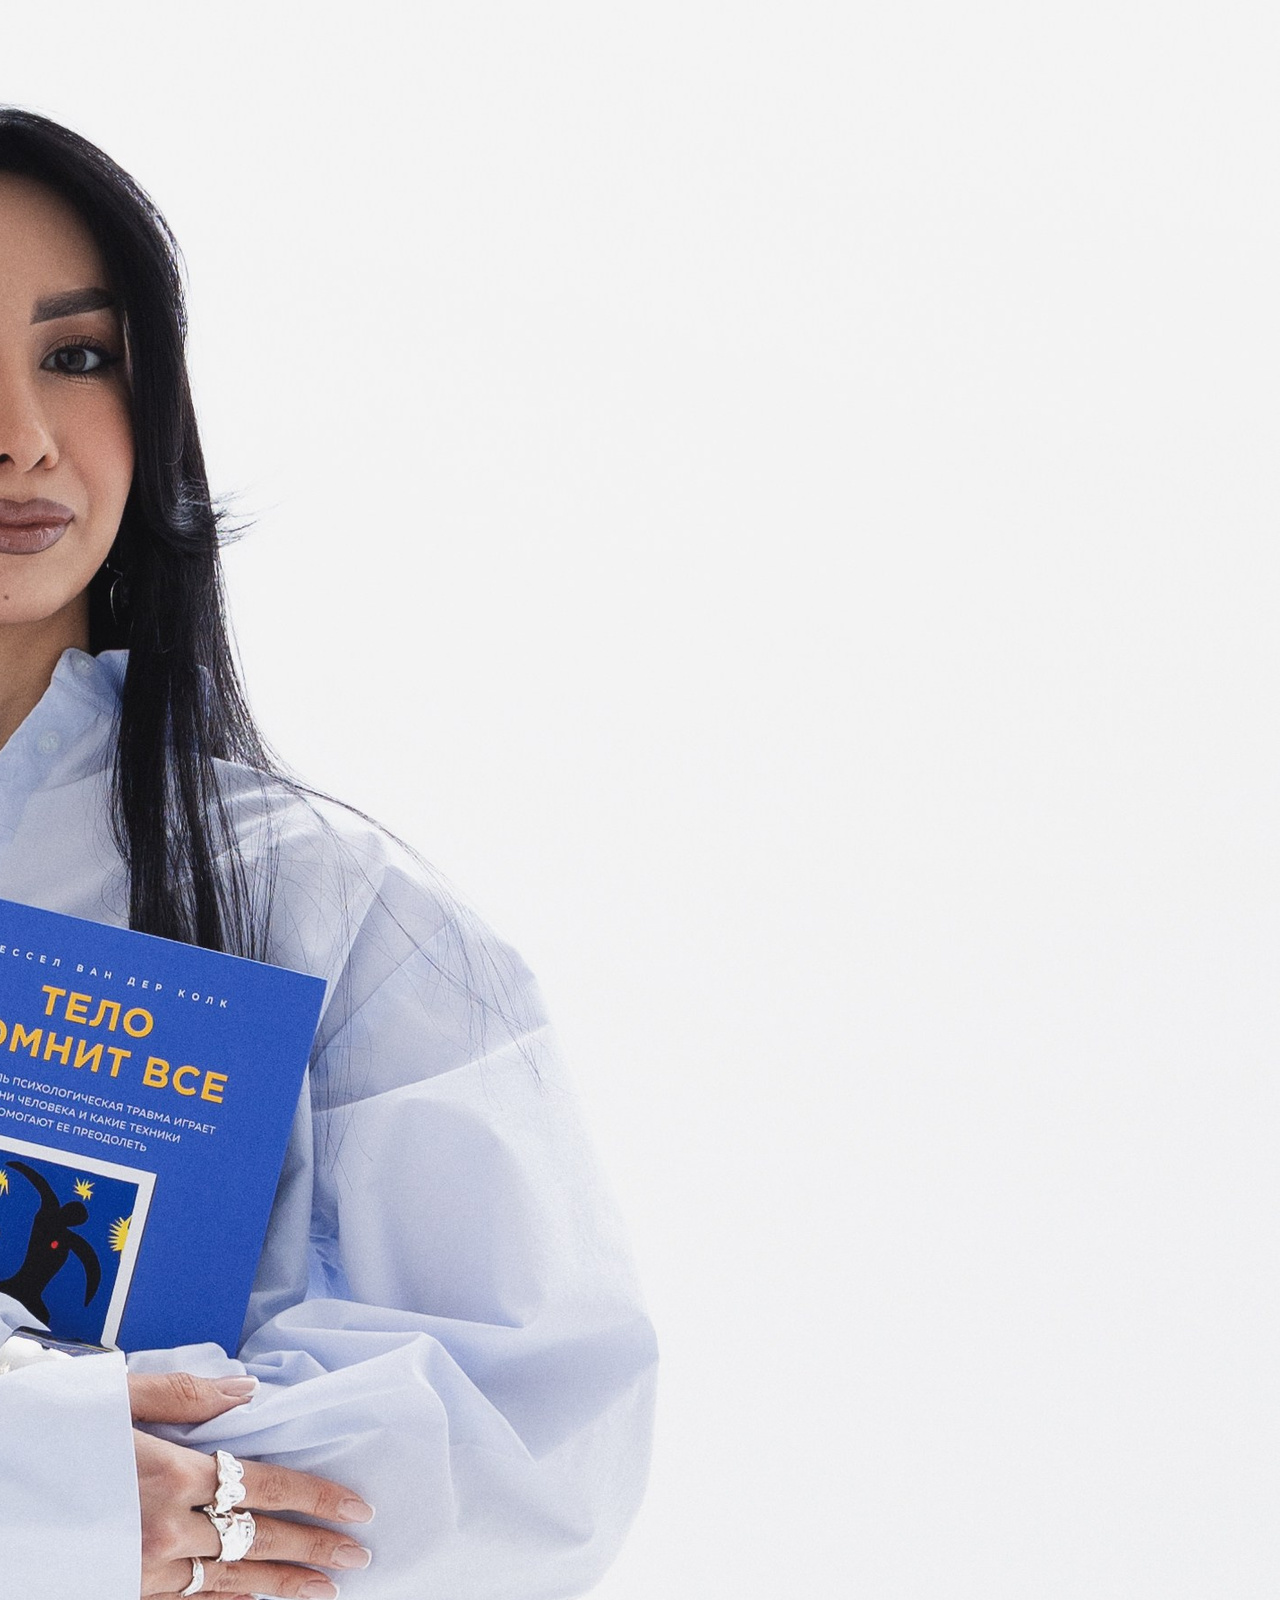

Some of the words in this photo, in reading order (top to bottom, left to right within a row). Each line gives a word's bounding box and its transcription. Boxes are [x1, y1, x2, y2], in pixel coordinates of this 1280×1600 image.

[76, 963, 112, 979] ВАН
[126, 976, 163, 992] ДЕР
[178, 989, 228, 1008] КОЛК
[41, 984, 154, 1038] ТЕЛО
[142, 1055, 229, 1104] ВСЕ
[12, 1076, 124, 1112] ПСИХОЛОГИЧЕСКАЯ
[126, 1104, 171, 1124] ТРАВМА
[173, 1117, 217, 1135] ИГРАЕТ
[17, 1095, 76, 1118] ЧЕЛОВЕКА
[78, 1110, 88, 1120] И
[89, 1113, 127, 1130] КАКИЕ
[129, 1122, 181, 1143] ТЕХНИКИ
[56, 1121, 71, 1133] ЕЕ
[72, 1125, 147, 1152] ПРЕОДОЛЕТЬ
